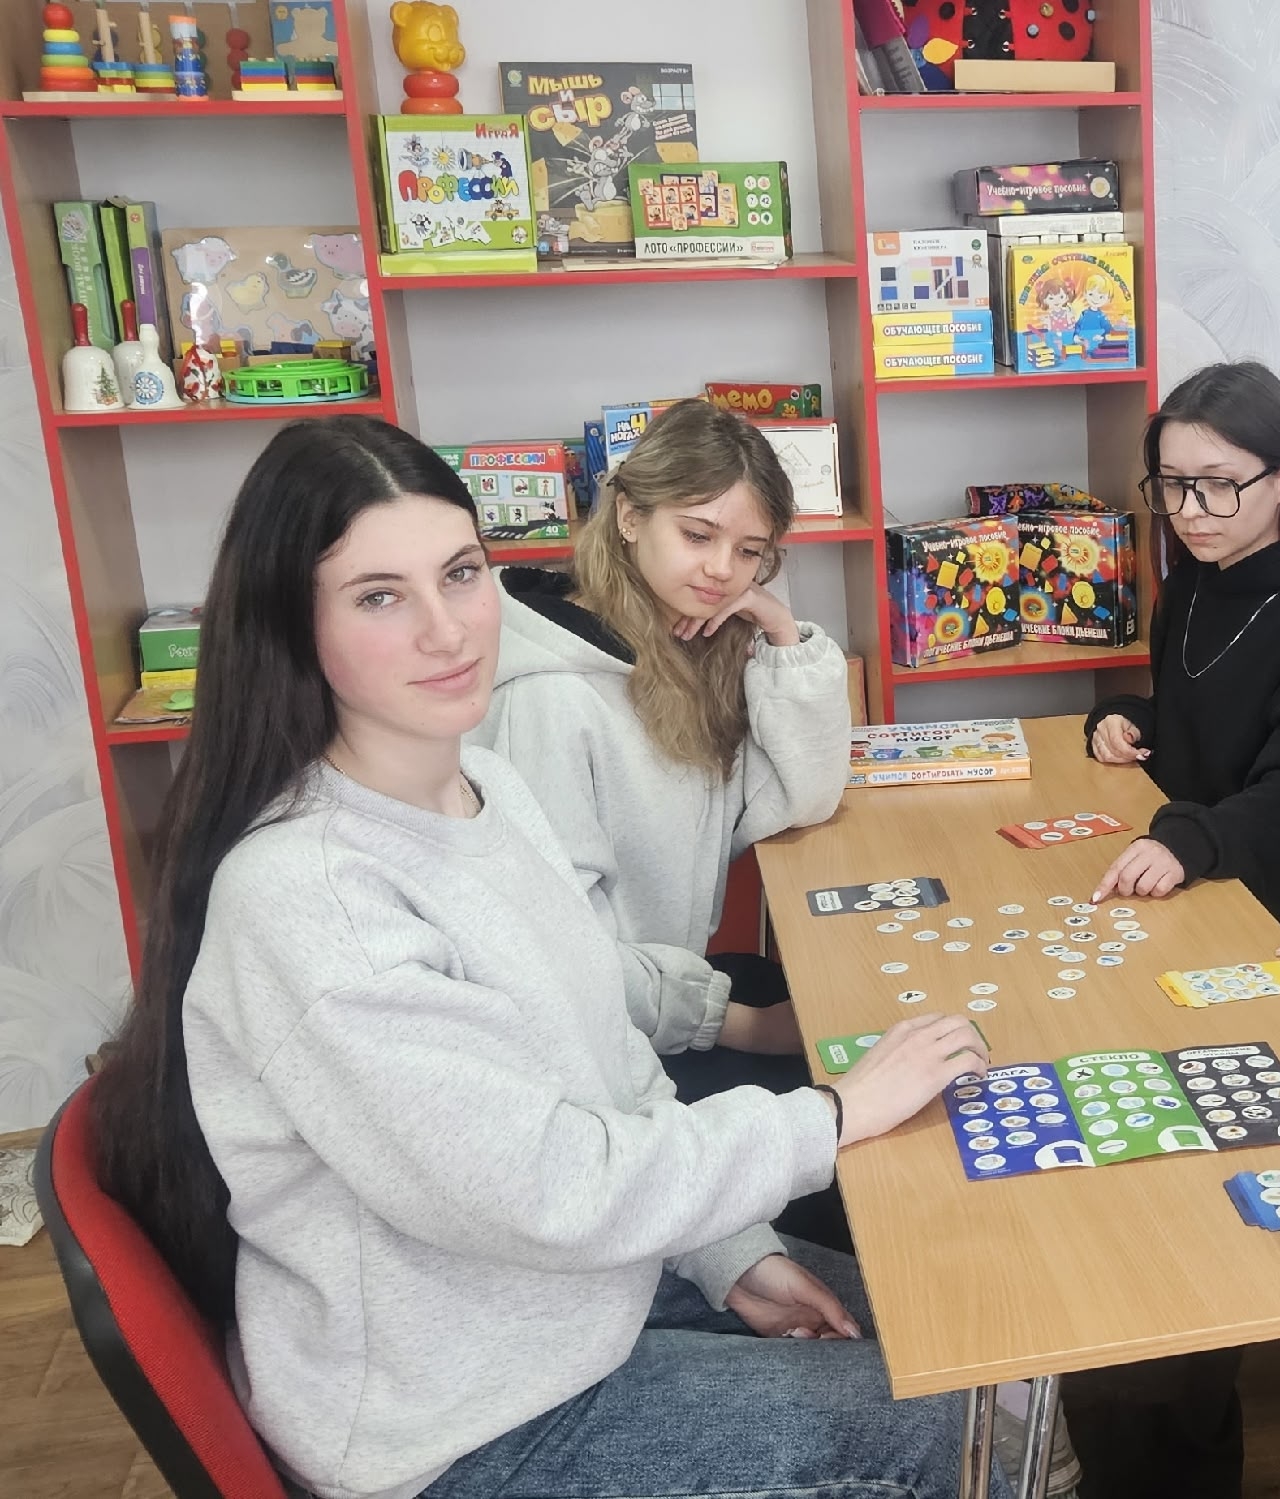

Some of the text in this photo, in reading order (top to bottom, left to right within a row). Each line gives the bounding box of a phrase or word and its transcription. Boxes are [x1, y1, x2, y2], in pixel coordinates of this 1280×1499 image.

[398, 170, 519, 204] ПРОФЕССИИ
[644, 242, 667, 254] ЛОТО
[670, 242, 744, 254] «ПРОФЕССИИ»
[883, 322, 983, 338] ОБУЧАЮЩЕЕ ПОСОБИЕ
[884, 354, 983, 367] ОБУЧАЮЩЕЕ ПОСОБИЕ
[617, 421, 632, 432] НА
[610, 428, 641, 443] НОГАХ
[470, 452, 545, 467] ПРОФЕССИИ
[545, 525, 559, 534] 40
[1052, 625, 1075, 637] БЛОКИ
[1075, 627, 1108, 640] ДЬЕНЕША
[923, 631, 1015, 659] ЛОГИЧЕСКИЕ БЛОКИ ДЬЕНЕША
[868, 727, 980, 739] СОРТИРОВАТЬ
[888, 723, 959, 732] УЧИМСЯ
[896, 734, 953, 742] МУСОР
[872, 772, 908, 782] УЧИМСЯ
[911, 769, 964, 780] СОРТИРОВАТЬ
[967, 768, 994, 777] МУСОР
[1079, 1052, 1140, 1063] СТЕКЛО
